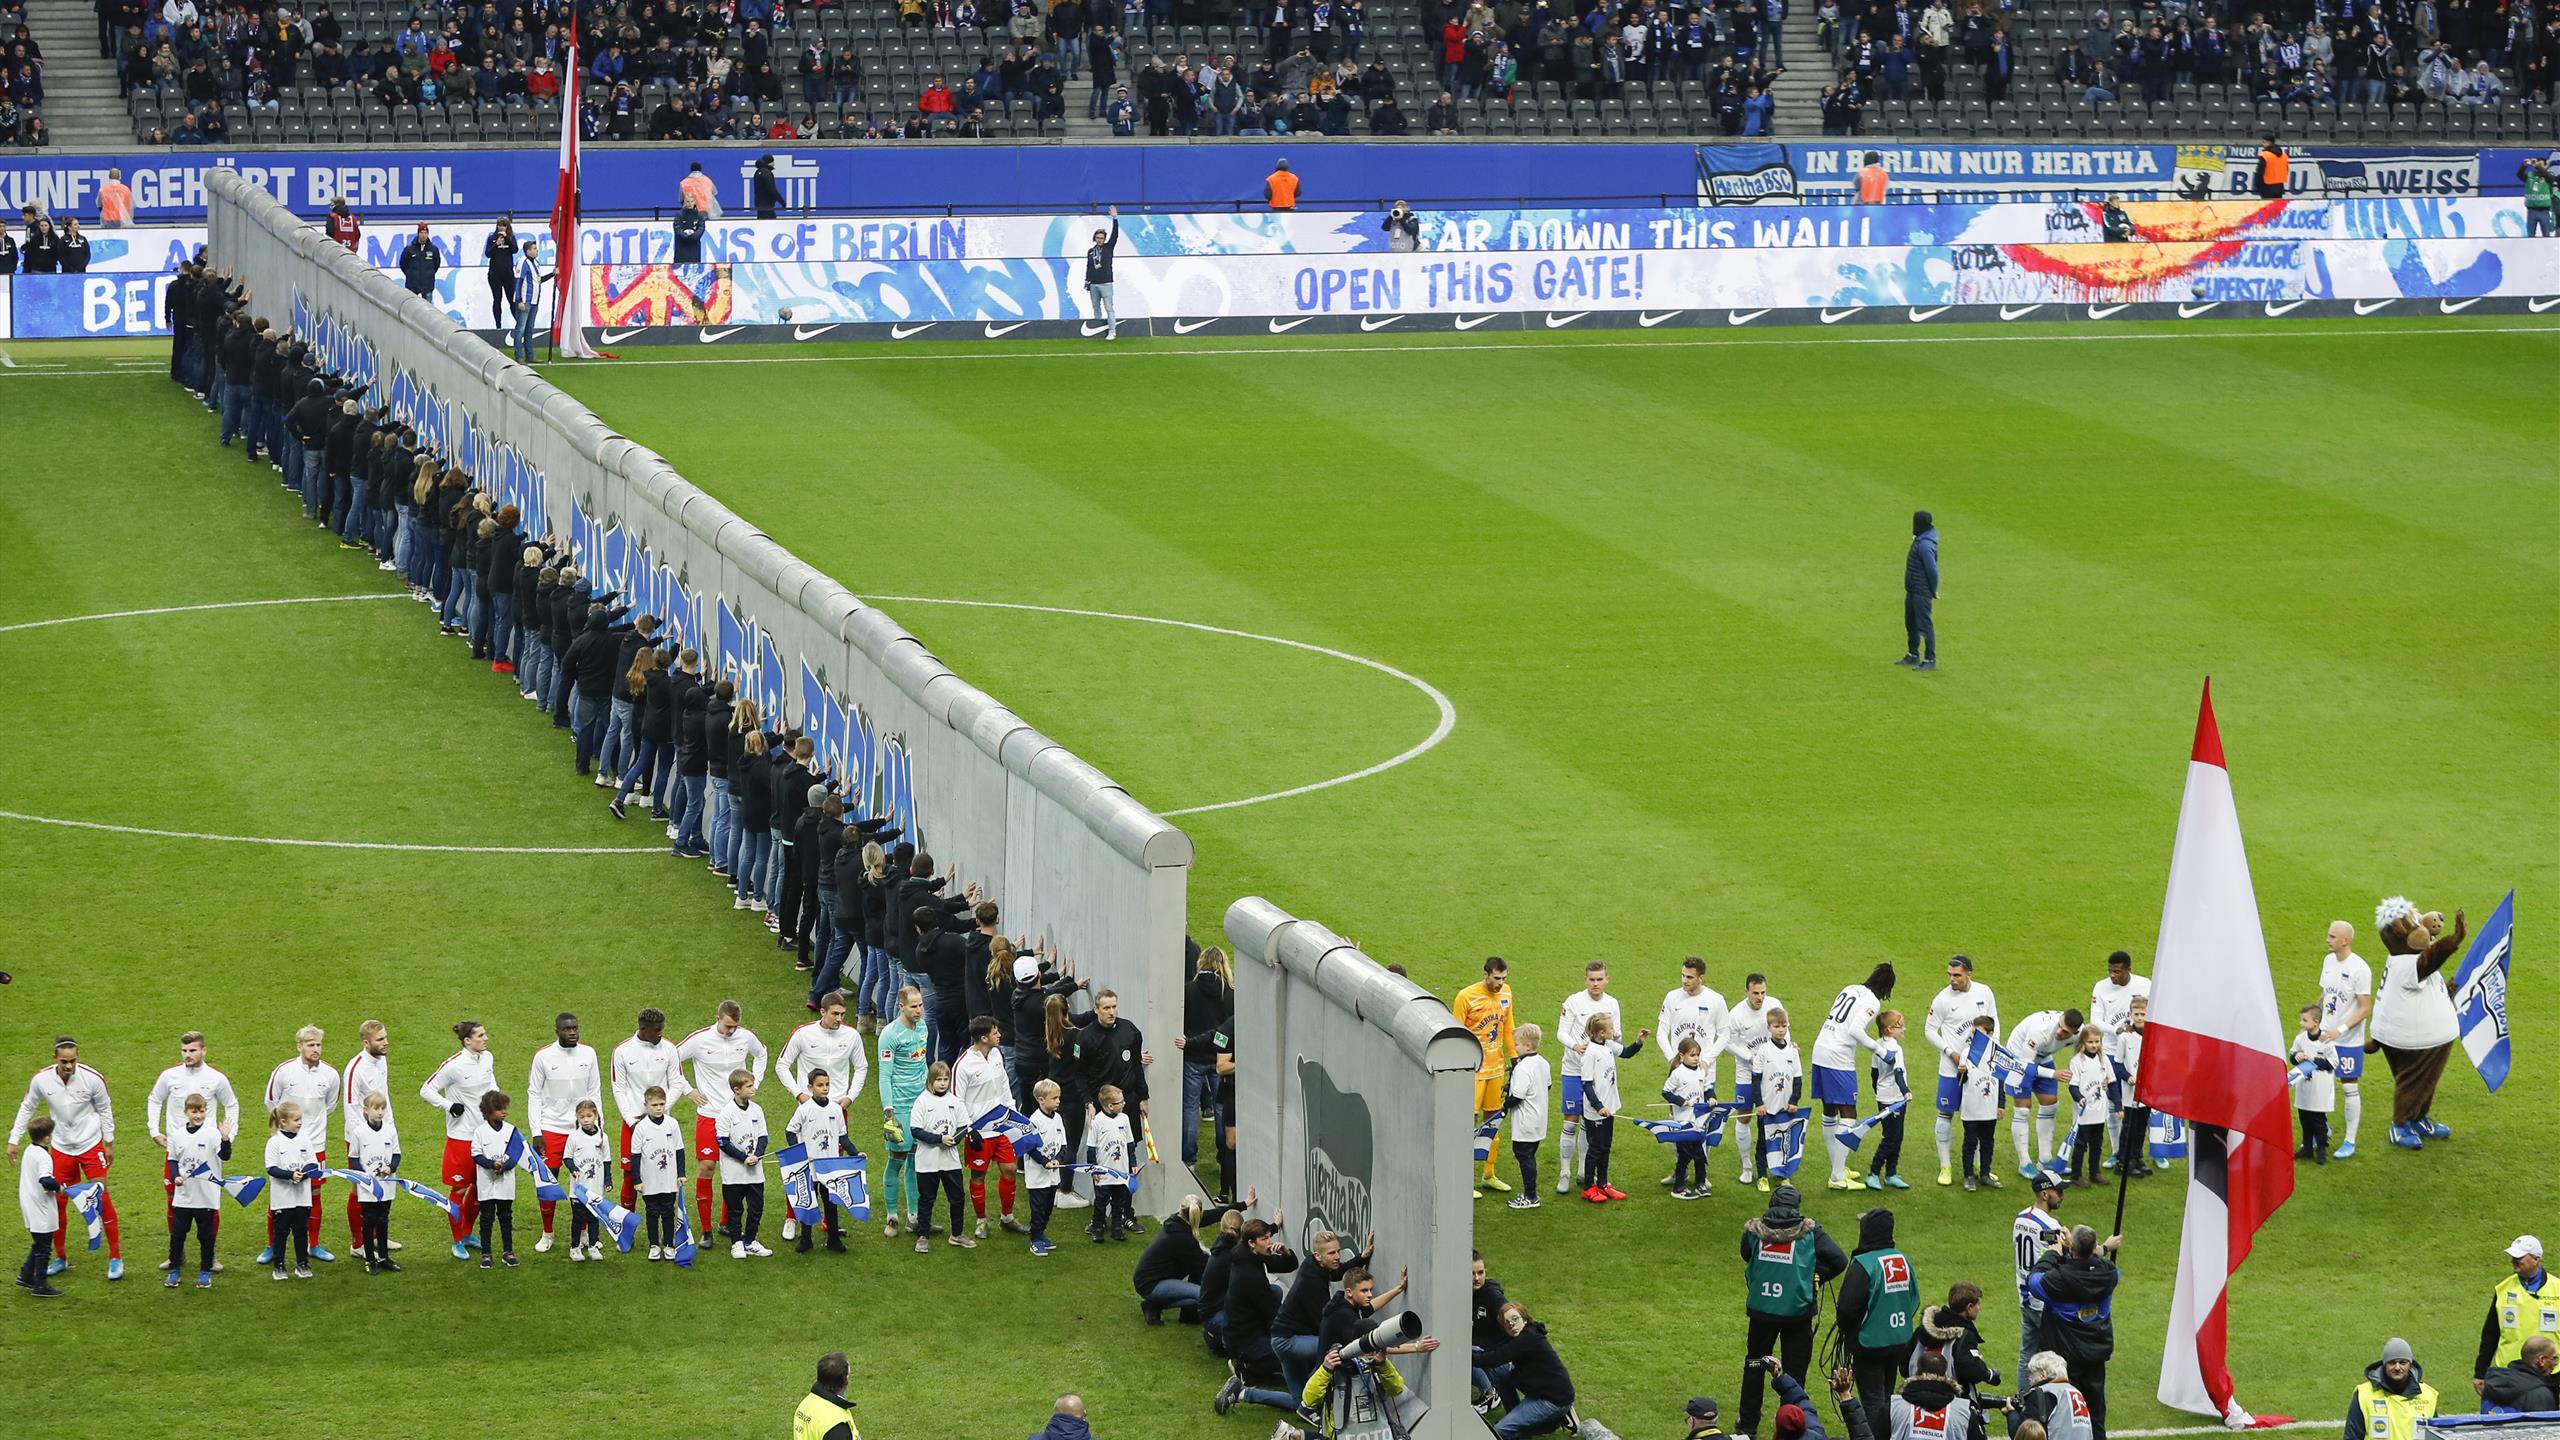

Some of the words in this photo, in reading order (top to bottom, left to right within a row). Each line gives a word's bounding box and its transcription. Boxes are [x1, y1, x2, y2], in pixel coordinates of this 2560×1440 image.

[1806, 150, 1839, 174] IN
[1846, 149, 1953, 175] BRLIN
[1959, 150, 2025, 175] NUR
[2031, 150, 2159, 175] HERTHA
[131, 157, 294, 210] GEHRT
[307, 166, 463, 206] BERLIN.
[2376, 168, 2471, 196] WEISS
[580, 226, 755, 264] CITIZNS
[771, 224, 817, 260] OF
[832, 218, 967, 261] BERLIN
[1418, 218, 1492, 252] EAR
[1509, 218, 1631, 250] DOWN
[1649, 218, 1736, 249] THIS
[1294, 266, 1401, 312] OPEN
[1421, 259, 1513, 308] THIS
[1532, 253, 1644, 301] GATE!
[1478, 1013, 1498, 1030] HERTHA
[1826, 992, 1856, 1024] 20
[1674, 1022, 1695, 1038] HERTHA
[2340, 1056, 2355, 1071] 30
[1310, 1151, 1347, 1233] Hertha
[1347, 1178, 1370, 1248] BSC
[1760, 1252, 1790, 1261] BUNDESLIGA
[2015, 1233, 2035, 1271] 10
[1761, 1281, 1783, 1298] 19
[1889, 1311, 1906, 1328] 03
